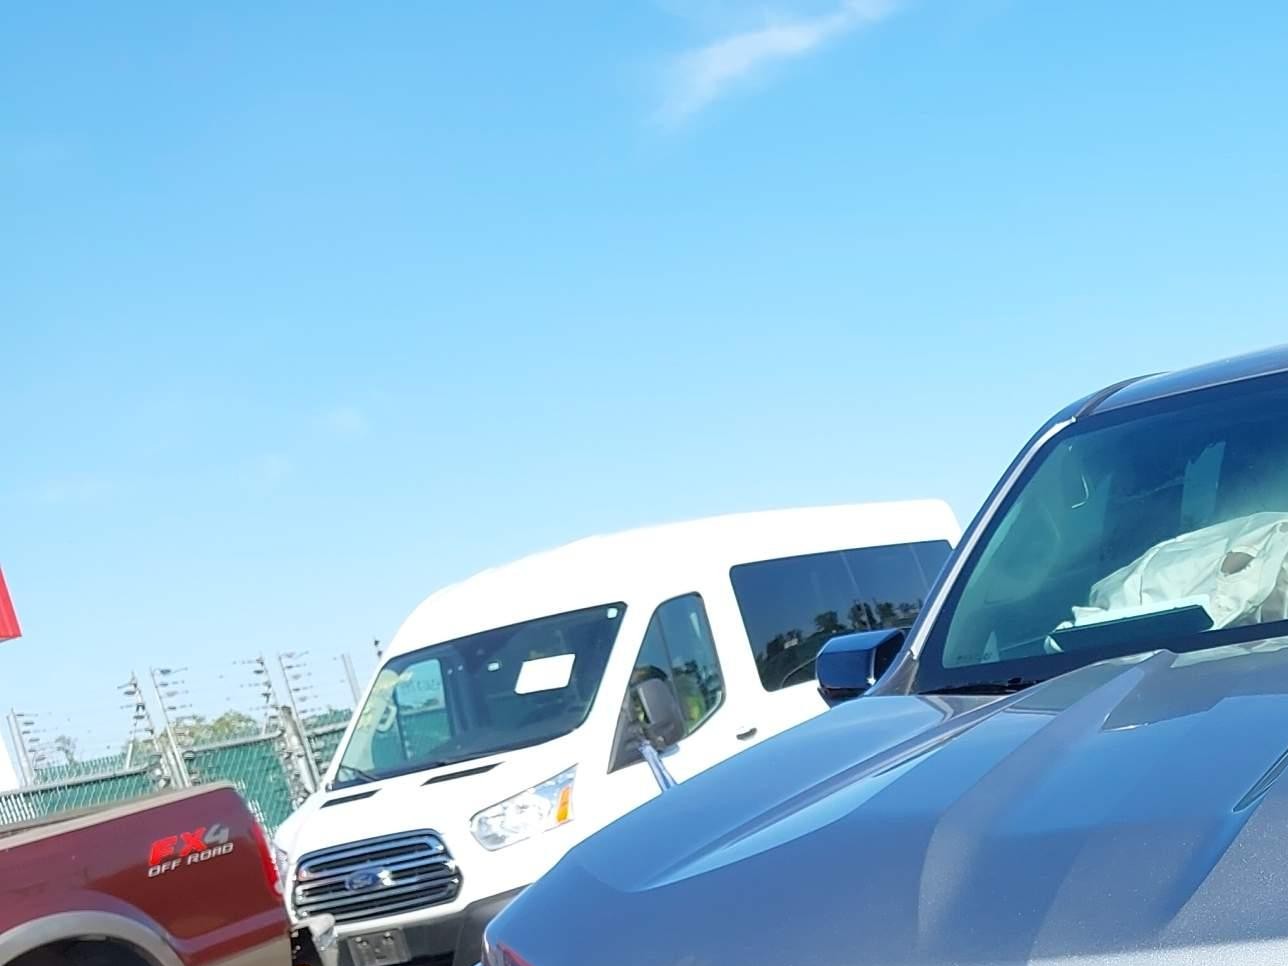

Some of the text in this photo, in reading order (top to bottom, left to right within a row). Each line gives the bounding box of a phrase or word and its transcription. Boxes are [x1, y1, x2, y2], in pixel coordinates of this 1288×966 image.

[147, 842, 235, 878] OFF ROAD
[149, 823, 230, 866] FX4
